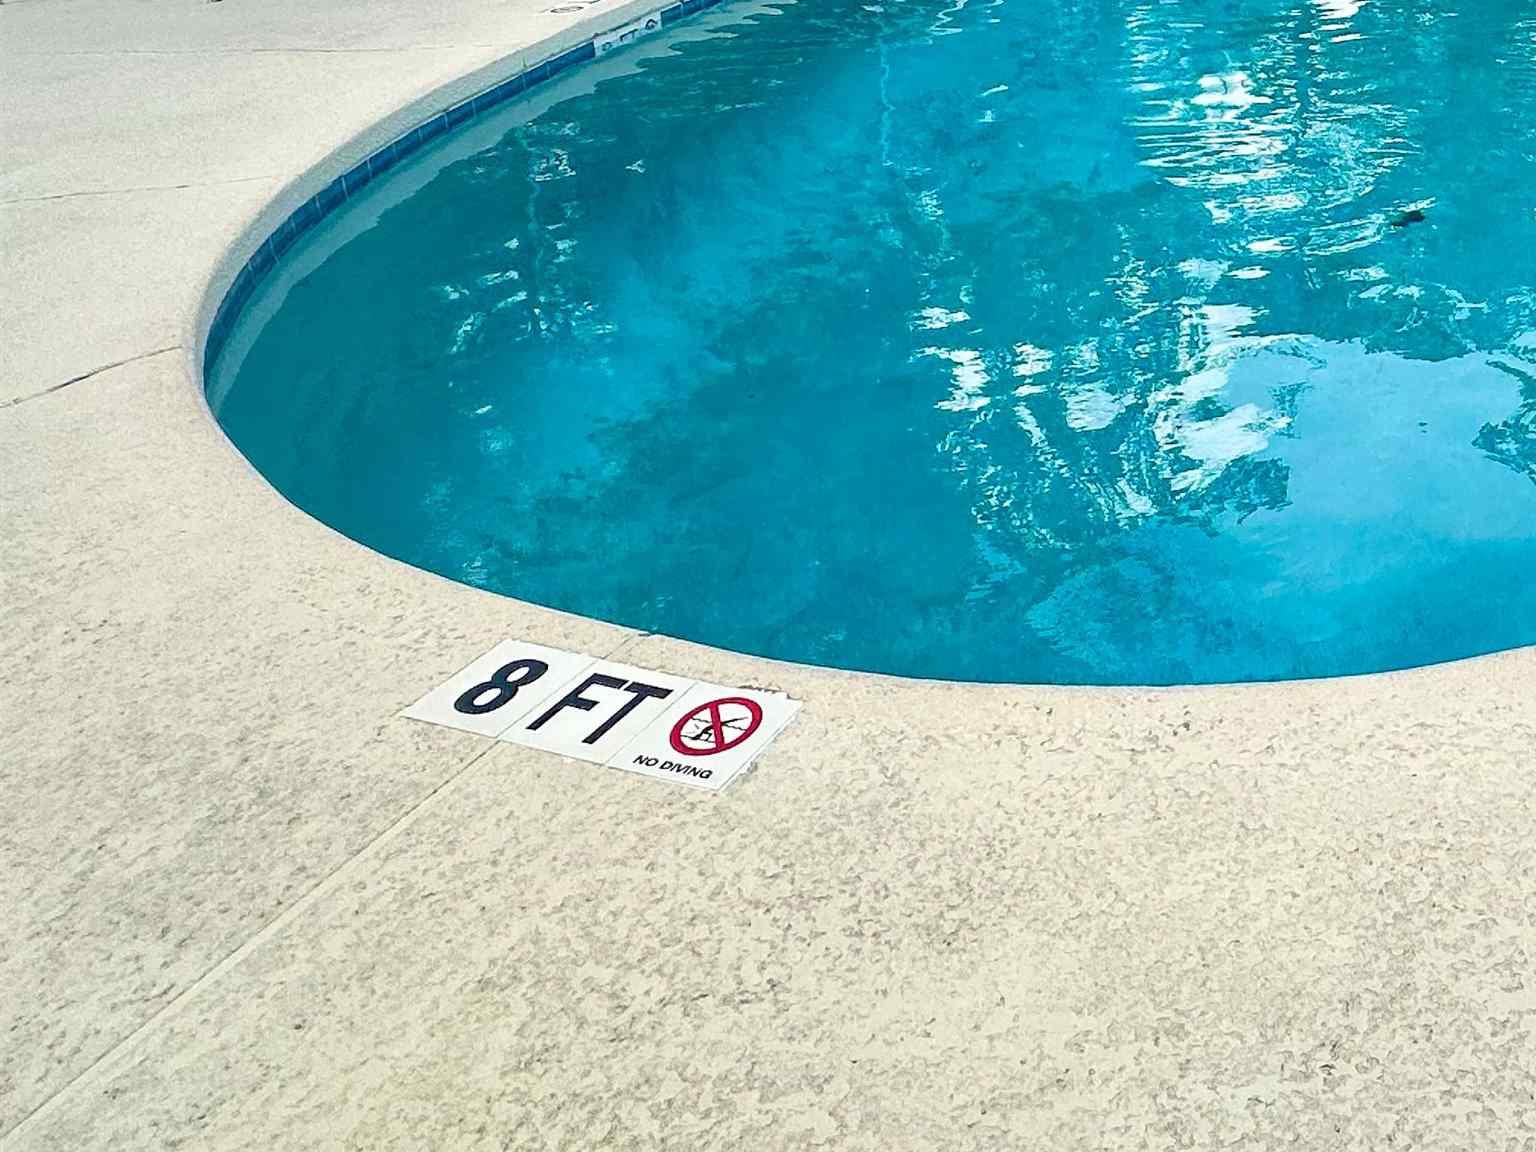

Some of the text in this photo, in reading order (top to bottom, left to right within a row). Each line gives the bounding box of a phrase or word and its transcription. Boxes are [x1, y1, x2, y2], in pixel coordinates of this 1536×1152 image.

[453, 658, 674, 745] 8 FT
[633, 754, 714, 781] NO DIVING
